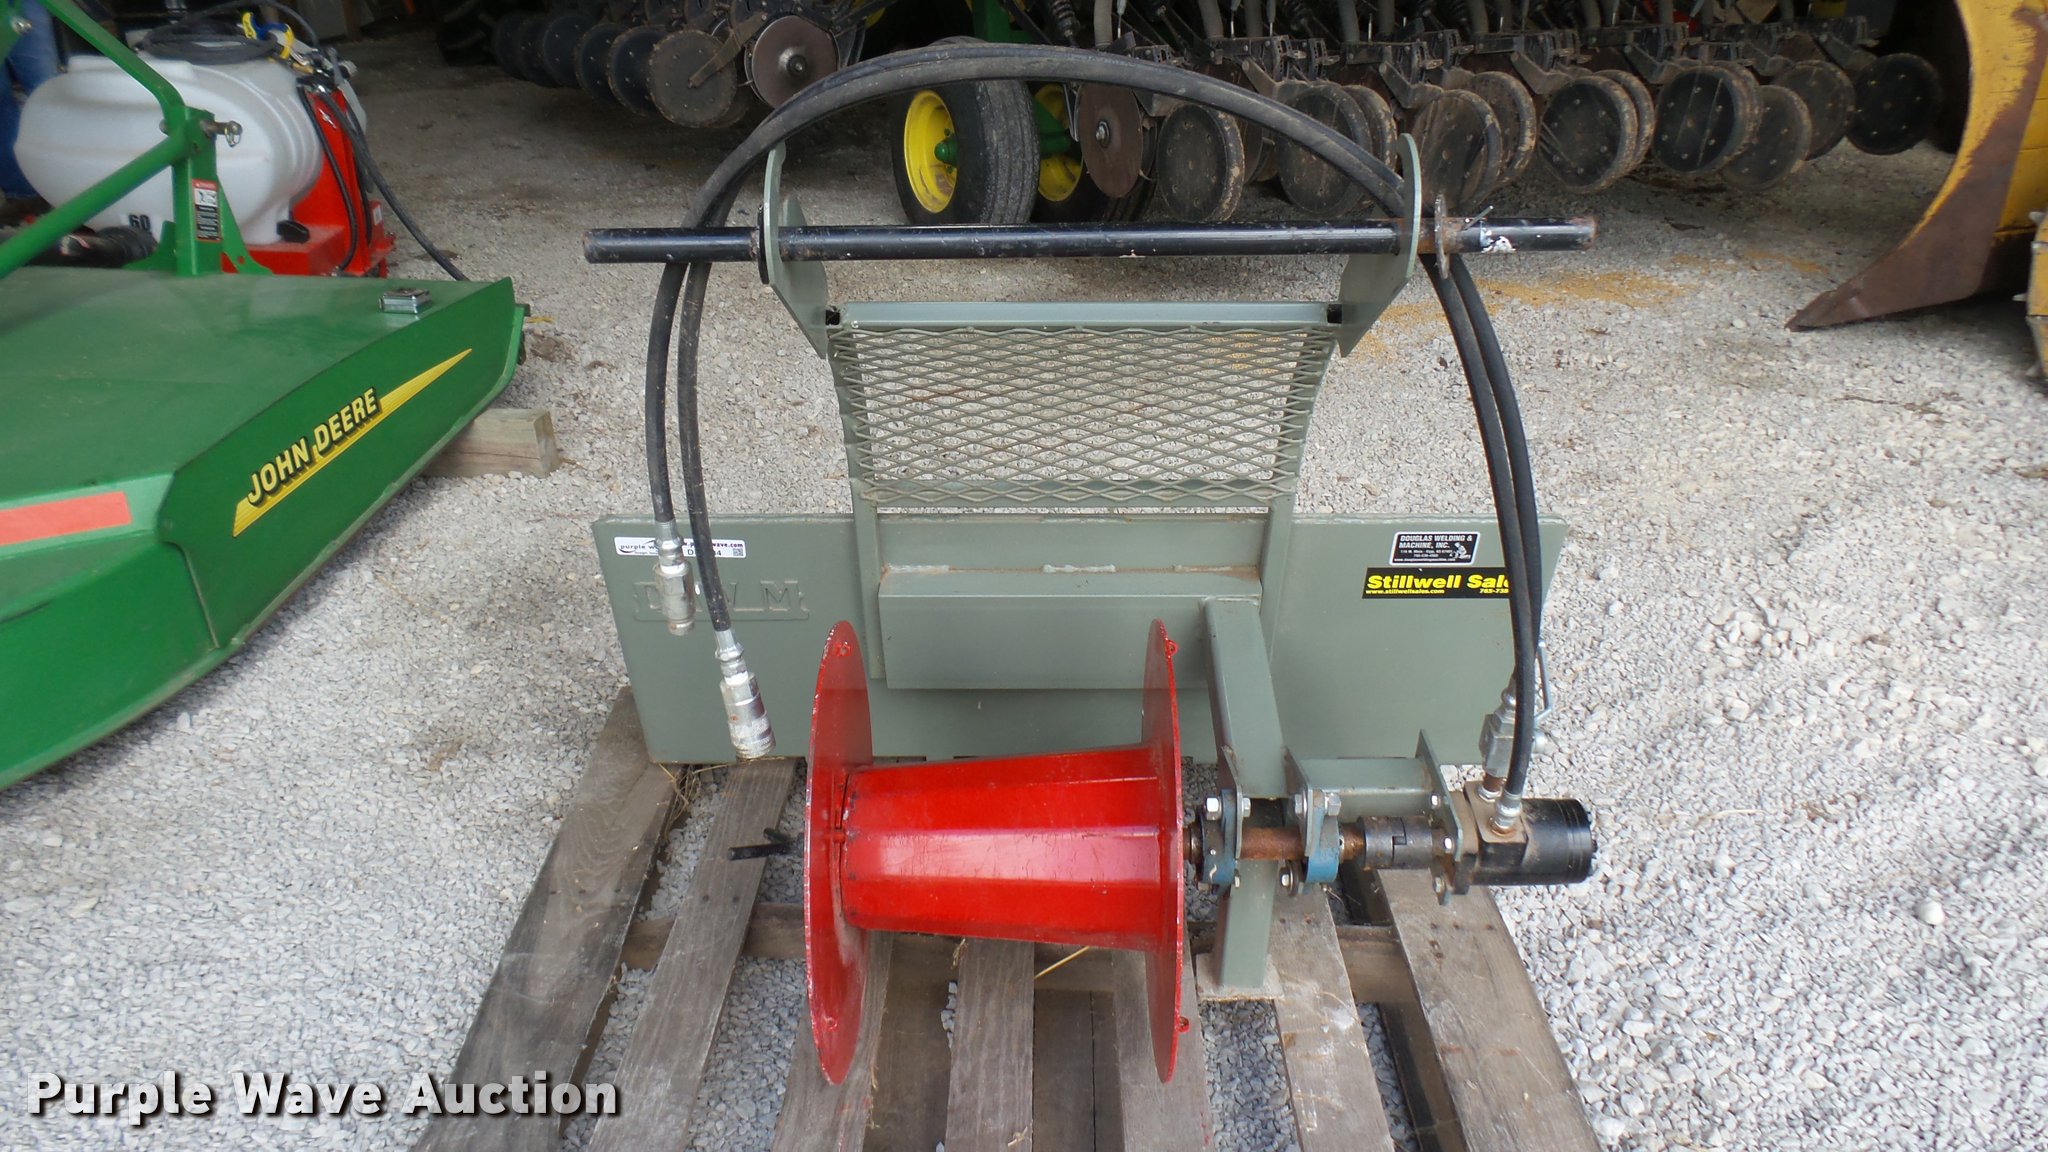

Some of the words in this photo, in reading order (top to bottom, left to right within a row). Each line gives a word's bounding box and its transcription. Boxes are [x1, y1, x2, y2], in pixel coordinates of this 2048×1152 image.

[128, 214, 150, 231] 60
[247, 436, 311, 507] JOHN
[313, 386, 380, 456] DEERE
[1366, 575, 1462, 589] Stillwell
